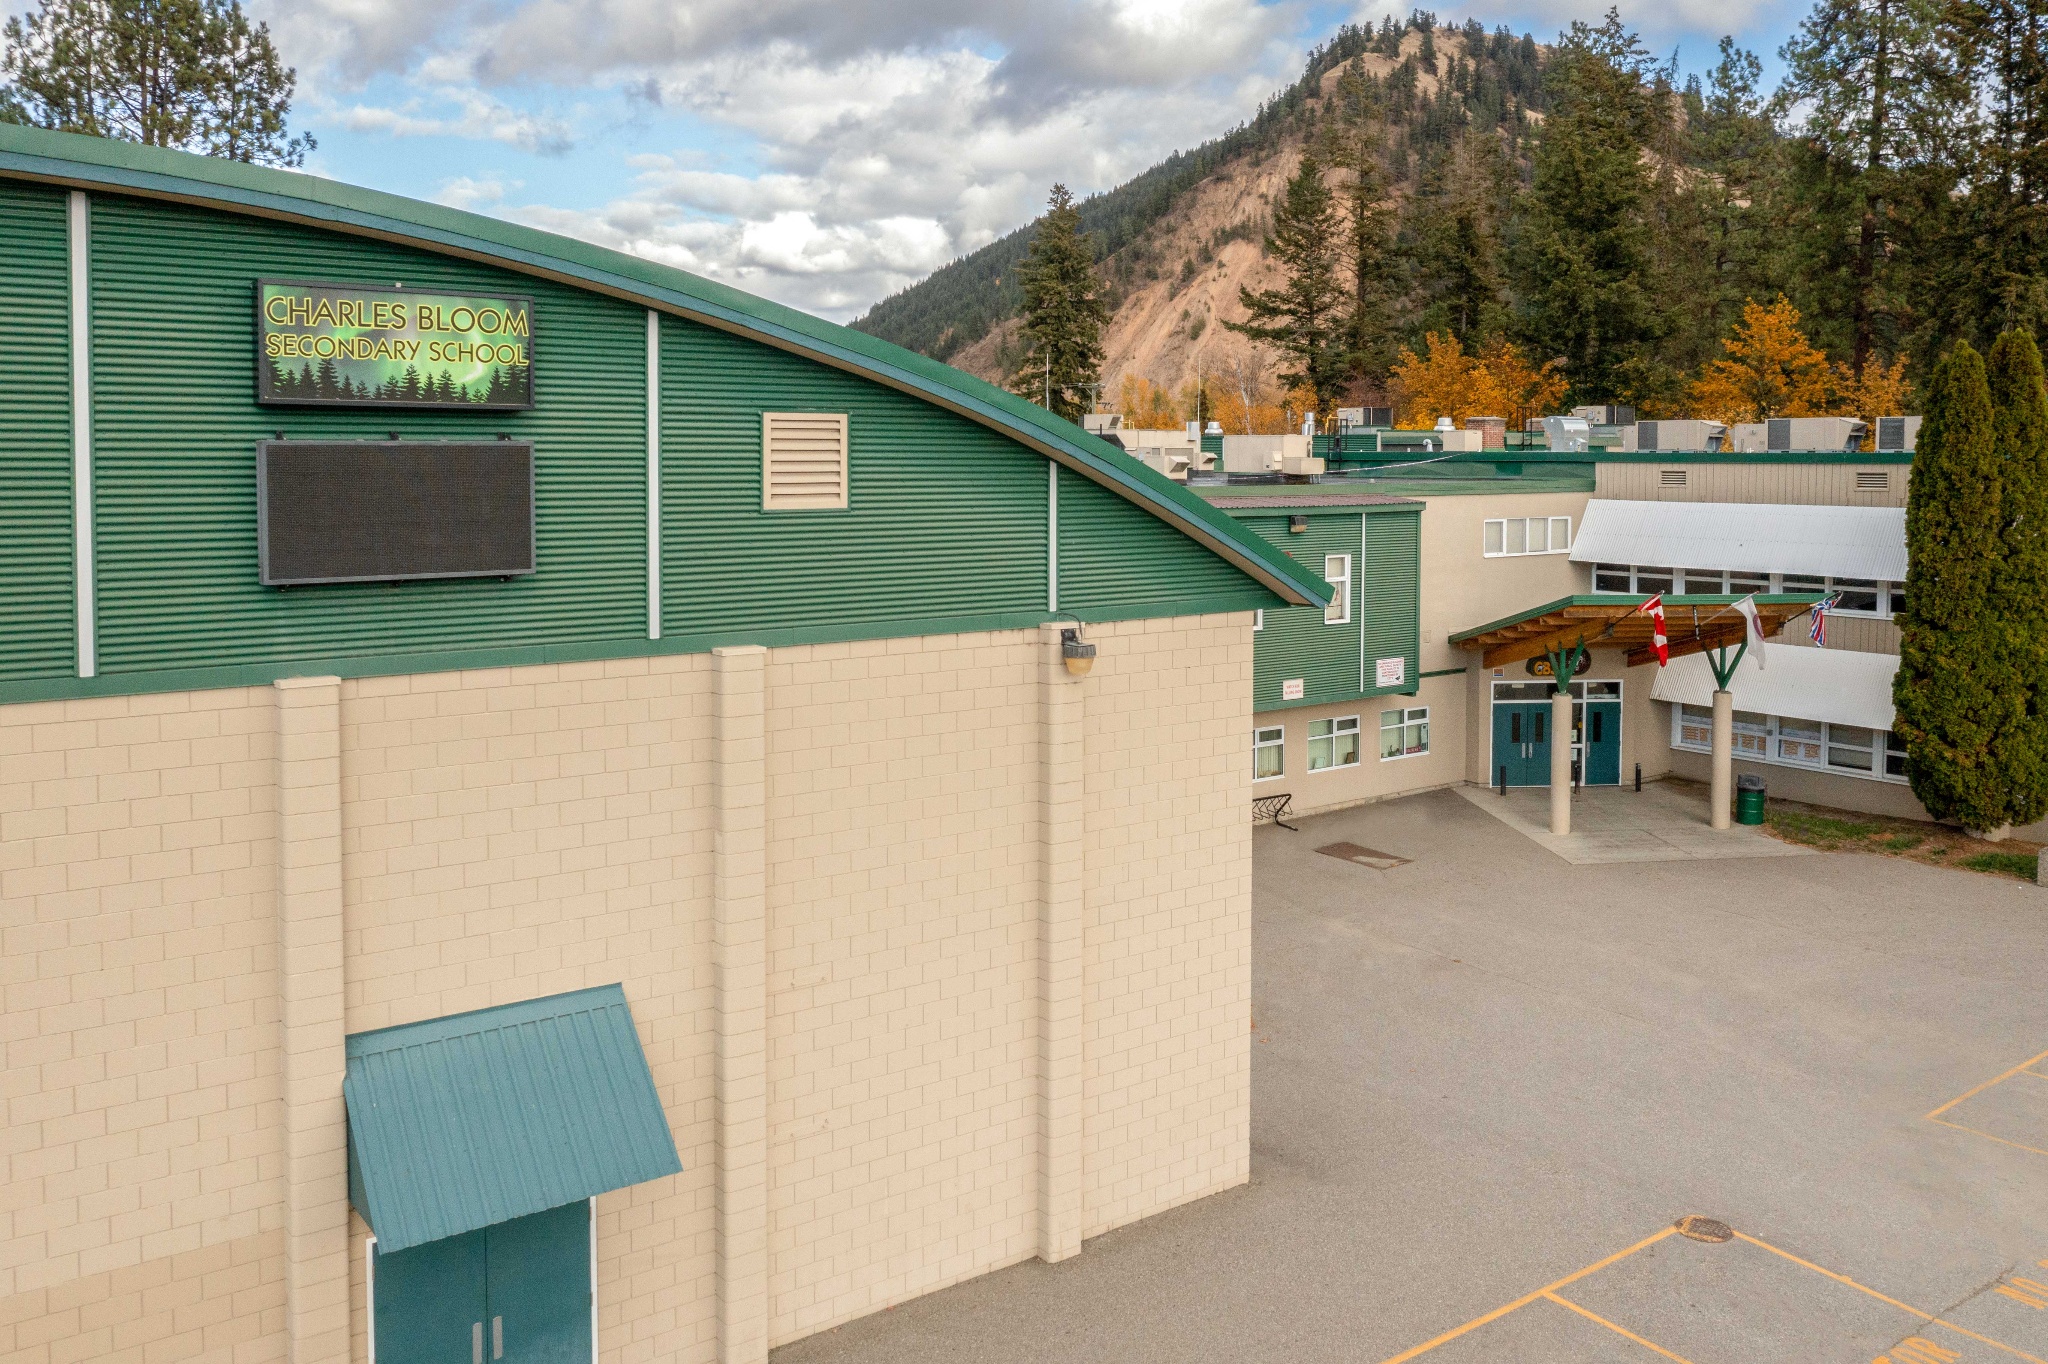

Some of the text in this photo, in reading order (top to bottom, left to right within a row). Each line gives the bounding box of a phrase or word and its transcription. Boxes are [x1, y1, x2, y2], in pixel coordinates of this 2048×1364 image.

[265, 296, 529, 336] CHARLES BLOOM
[265, 333, 530, 366] SECONDARY SCHOOL
